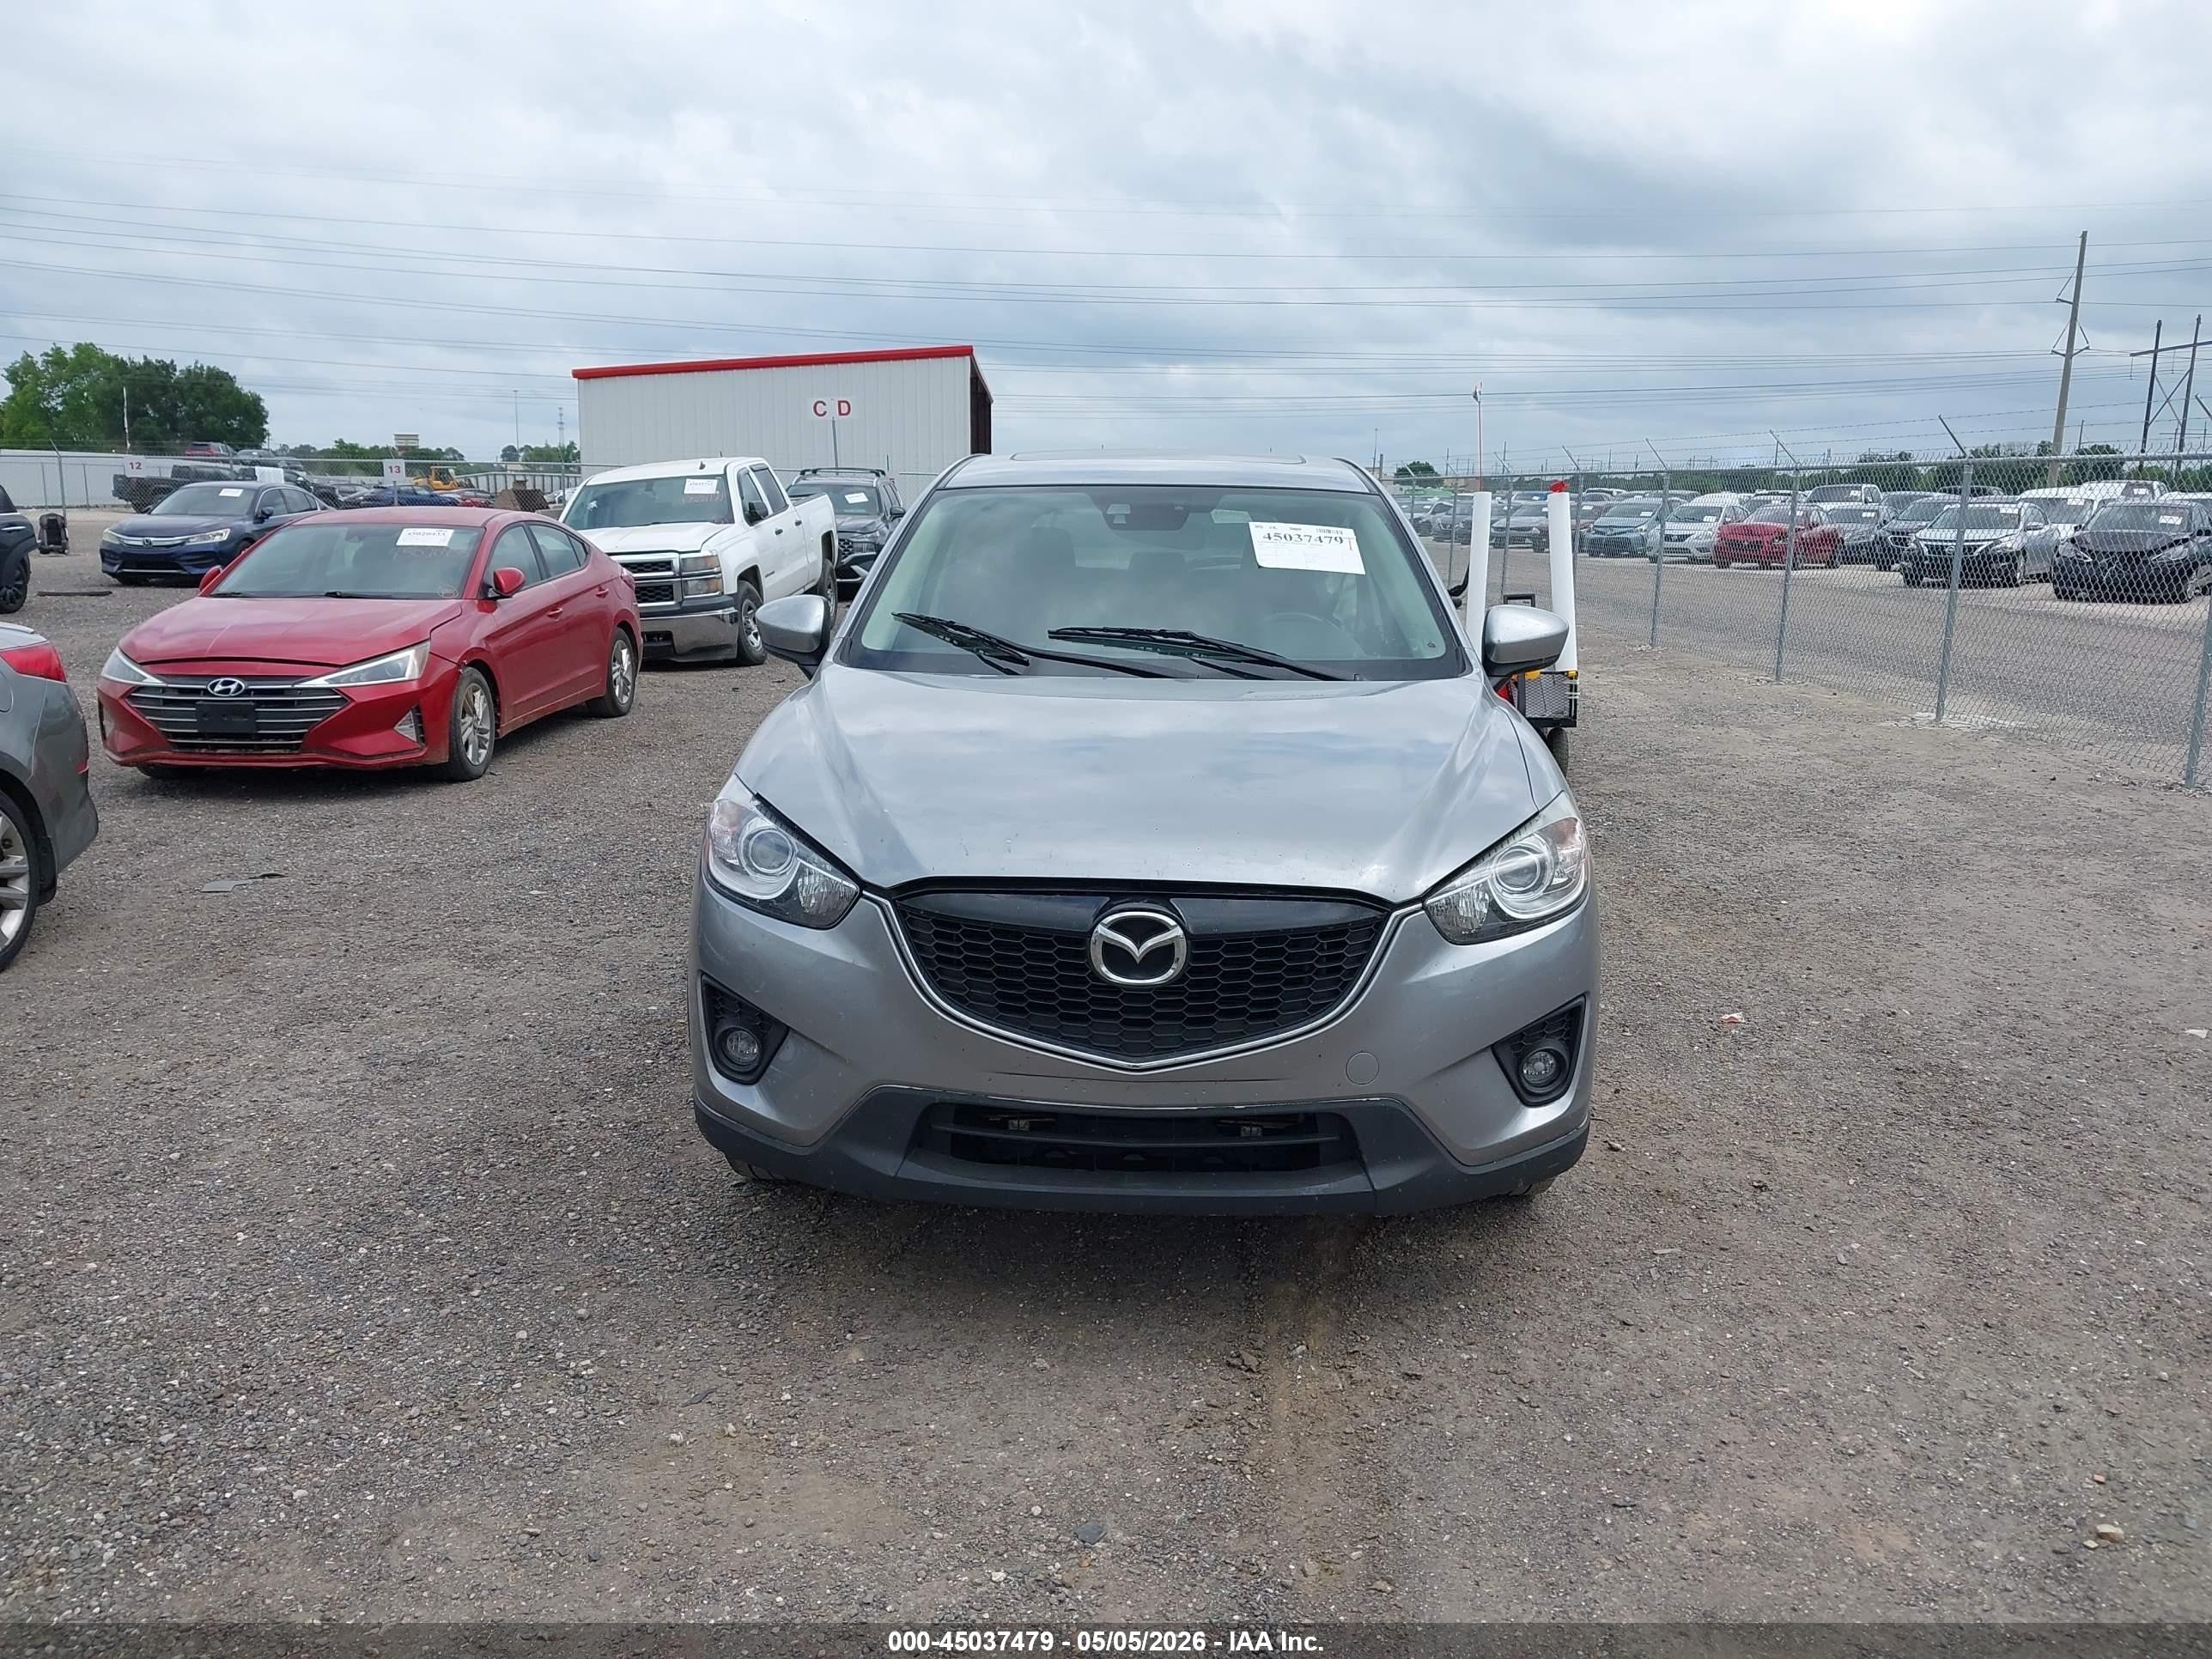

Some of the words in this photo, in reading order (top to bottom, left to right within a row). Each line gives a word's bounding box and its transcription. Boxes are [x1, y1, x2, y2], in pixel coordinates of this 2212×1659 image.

[813, 400, 827, 416] C
[837, 400, 851, 416] D
[129, 461, 143, 470] 12
[1262, 532, 1344, 544] 45037479
